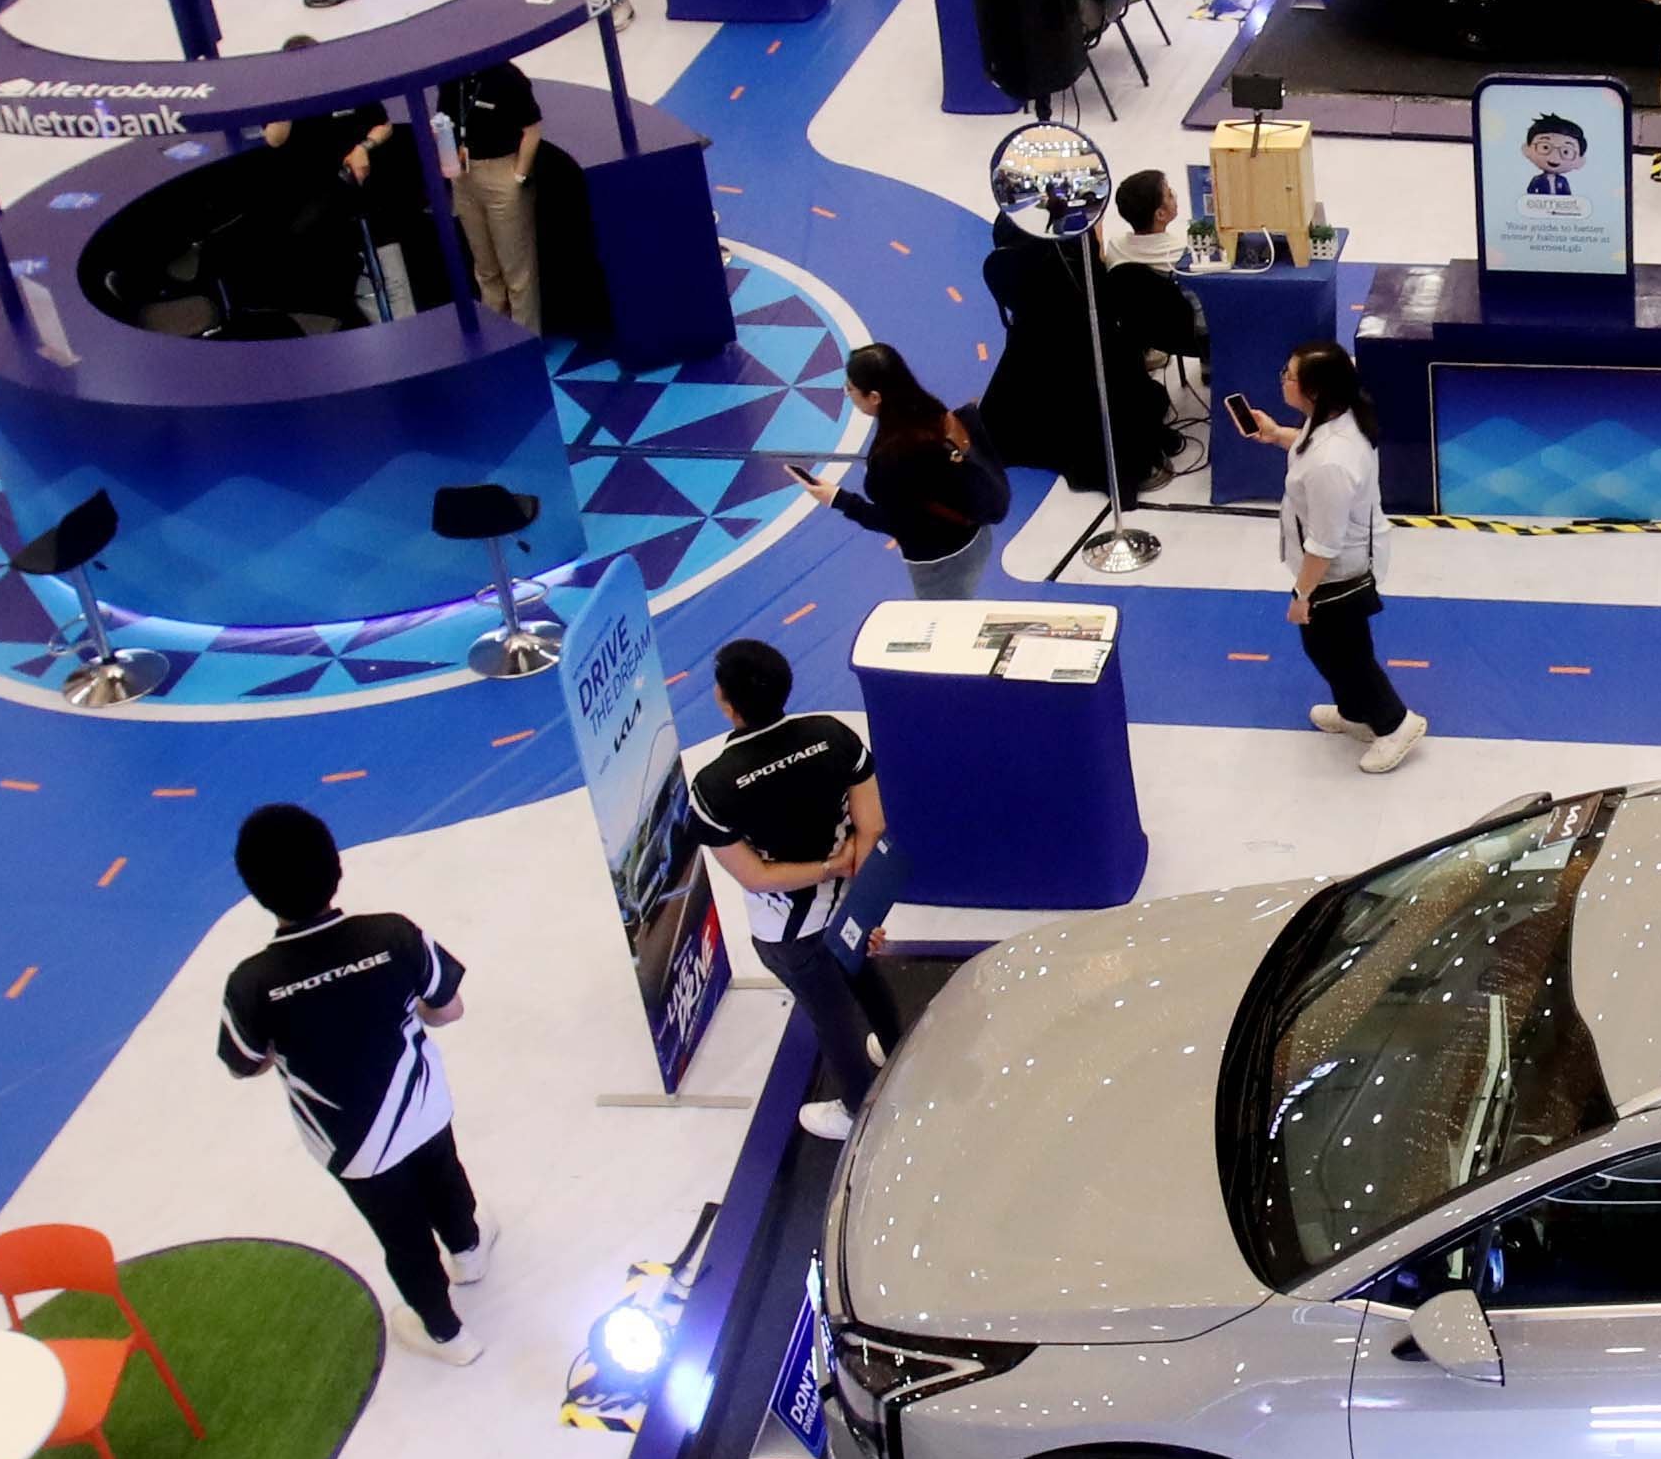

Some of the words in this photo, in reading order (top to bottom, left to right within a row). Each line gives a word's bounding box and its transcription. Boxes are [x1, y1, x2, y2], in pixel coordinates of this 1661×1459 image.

[35, 82, 216, 99] Metrobank
[2, 105, 187, 138] Metrobank
[579, 615, 630, 716] DRIVE
[590, 689, 614, 736] THE
[615, 627, 652, 700] DREAM
[736, 741, 829, 789] SPORTAGE
[268, 950, 392, 1001] SPORTAGE
[667, 956, 689, 1026] LIVE
[678, 924, 714, 1044] DRIVE
